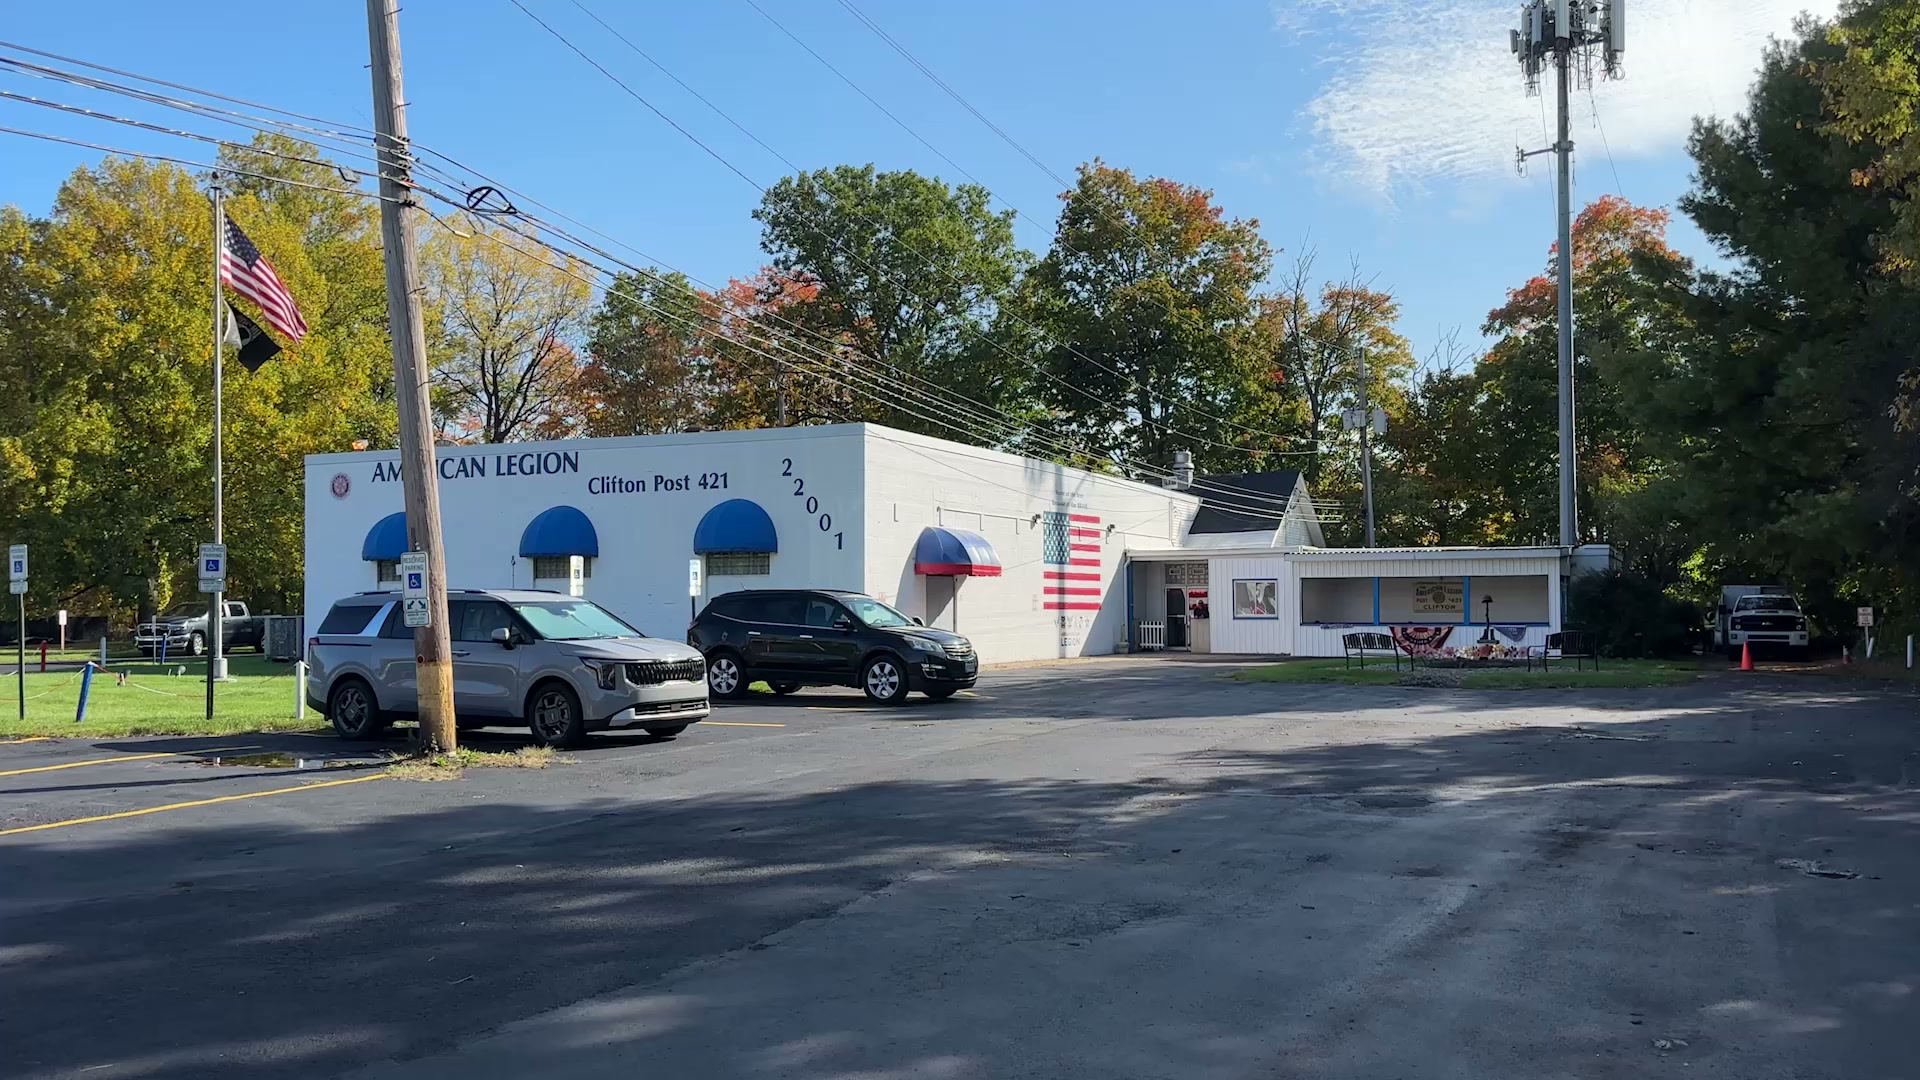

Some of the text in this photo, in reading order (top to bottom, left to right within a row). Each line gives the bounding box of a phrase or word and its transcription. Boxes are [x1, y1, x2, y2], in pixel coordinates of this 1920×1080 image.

[371, 452, 579, 482] AMICAN LEGION
[588, 472, 729, 494] Clifton Post 421
